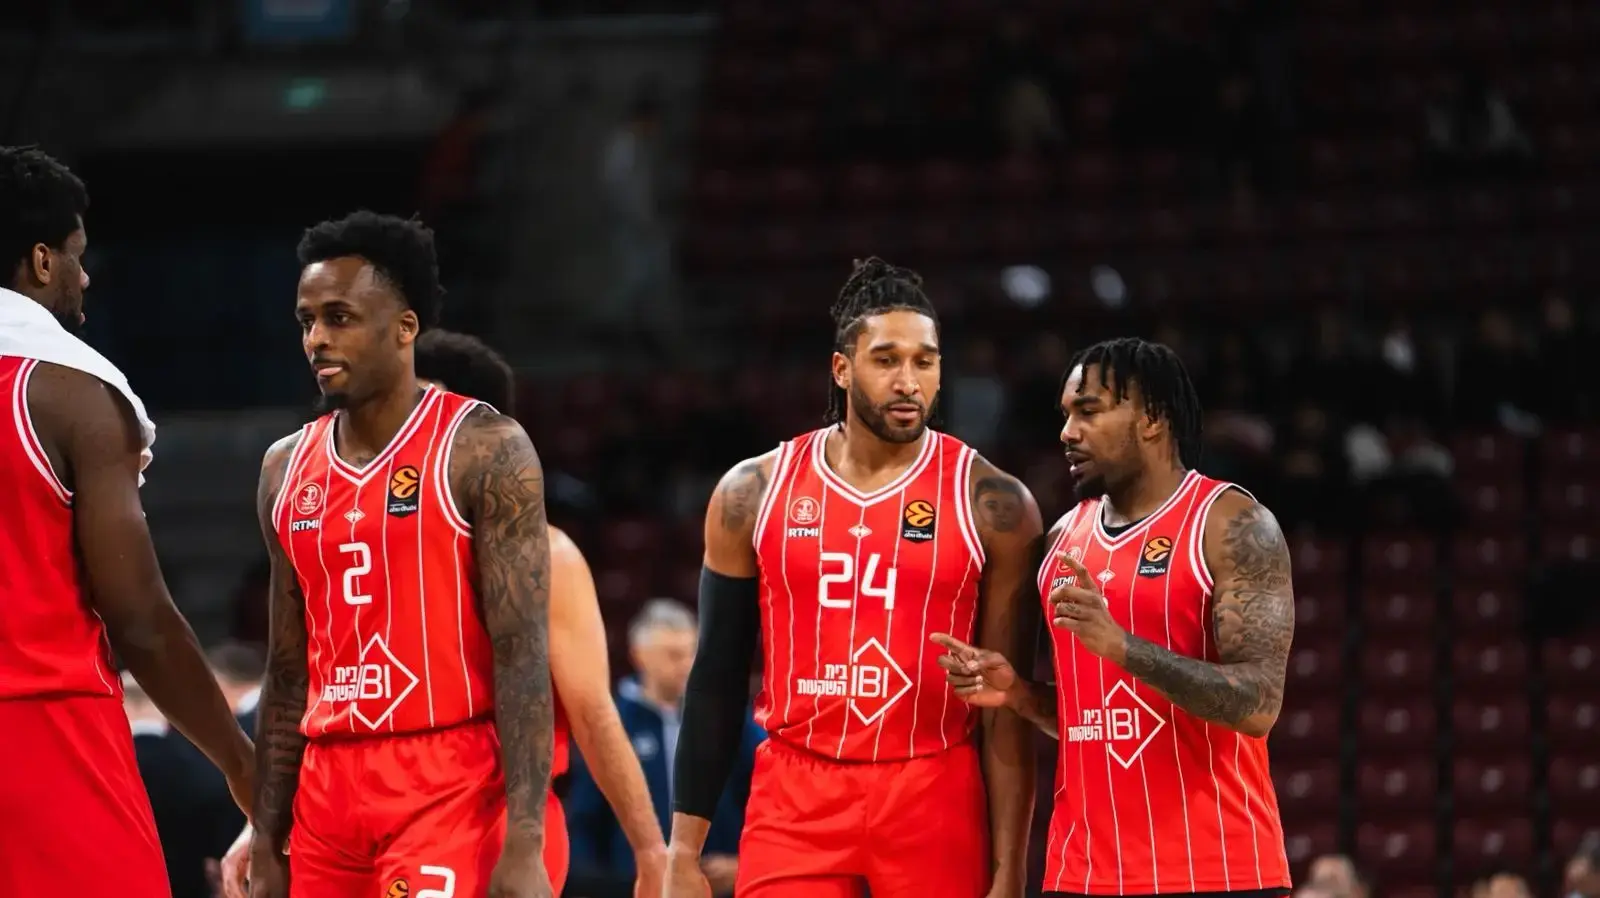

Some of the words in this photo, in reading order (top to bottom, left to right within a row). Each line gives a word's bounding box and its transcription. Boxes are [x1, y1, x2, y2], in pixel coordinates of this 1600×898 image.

[338, 541, 373, 606] 2
[818, 552, 897, 610] 24
[797, 679, 847, 697] השקעות
[824, 664, 848, 680] בית
[850, 664, 889, 699] IBI
[1083, 708, 1103, 725] בית
[1105, 707, 1141, 741] IBI
